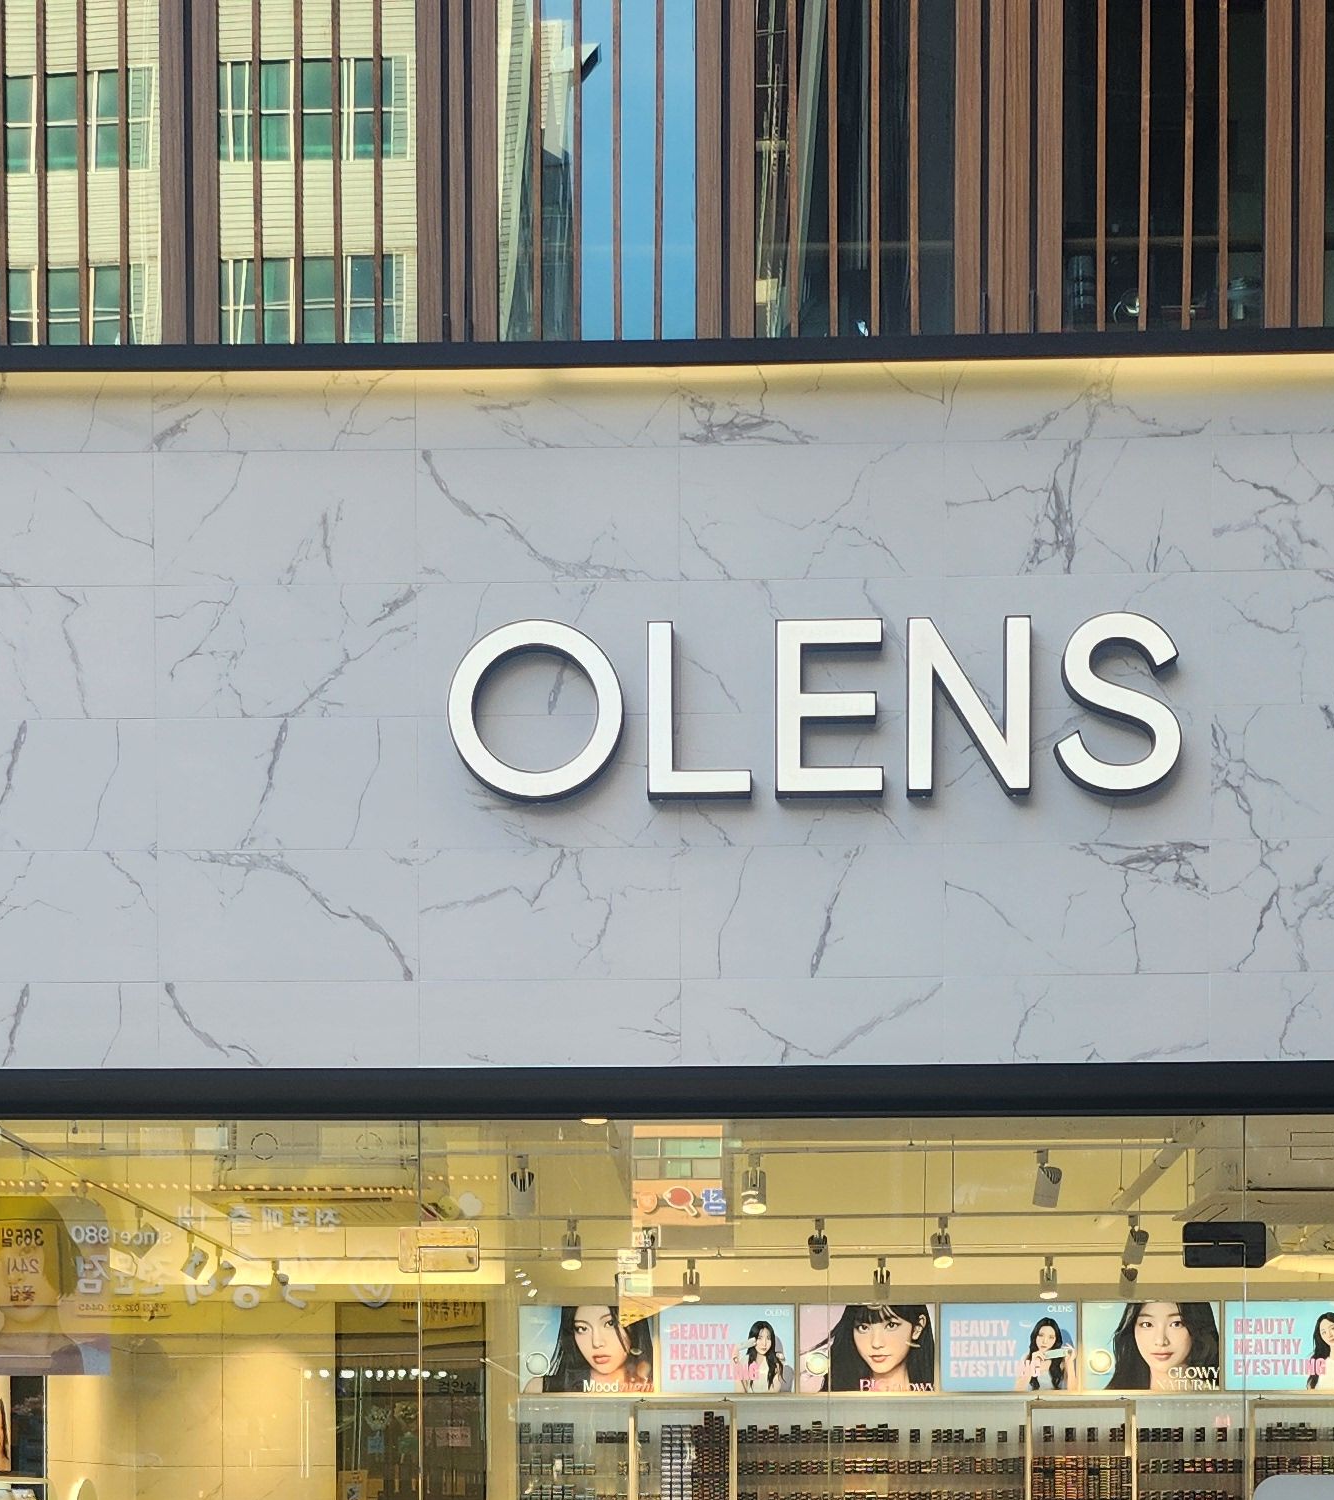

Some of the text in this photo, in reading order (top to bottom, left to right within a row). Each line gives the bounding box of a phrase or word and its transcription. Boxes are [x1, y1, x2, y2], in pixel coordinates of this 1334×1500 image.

[447, 612, 1183, 802] OLENS
[1047, 1304, 1073, 1313] OLENS
[669, 1323, 729, 1340] BEAUTY
[950, 1319, 1010, 1337] BEAUTY
[1234, 1318, 1295, 1335] BEAUTY
[669, 1343, 736, 1361] HEALTHY
[950, 1340, 1016, 1358] HEALTHY
[1234, 1338, 1301, 1356] HEALTHY
[669, 1363, 760, 1381] EYESTYLING
[1168, 1366, 1220, 1379] GLOWY
[1234, 1358, 1326, 1376] EYESTYLING
[583, 1379, 619, 1393] Mood
